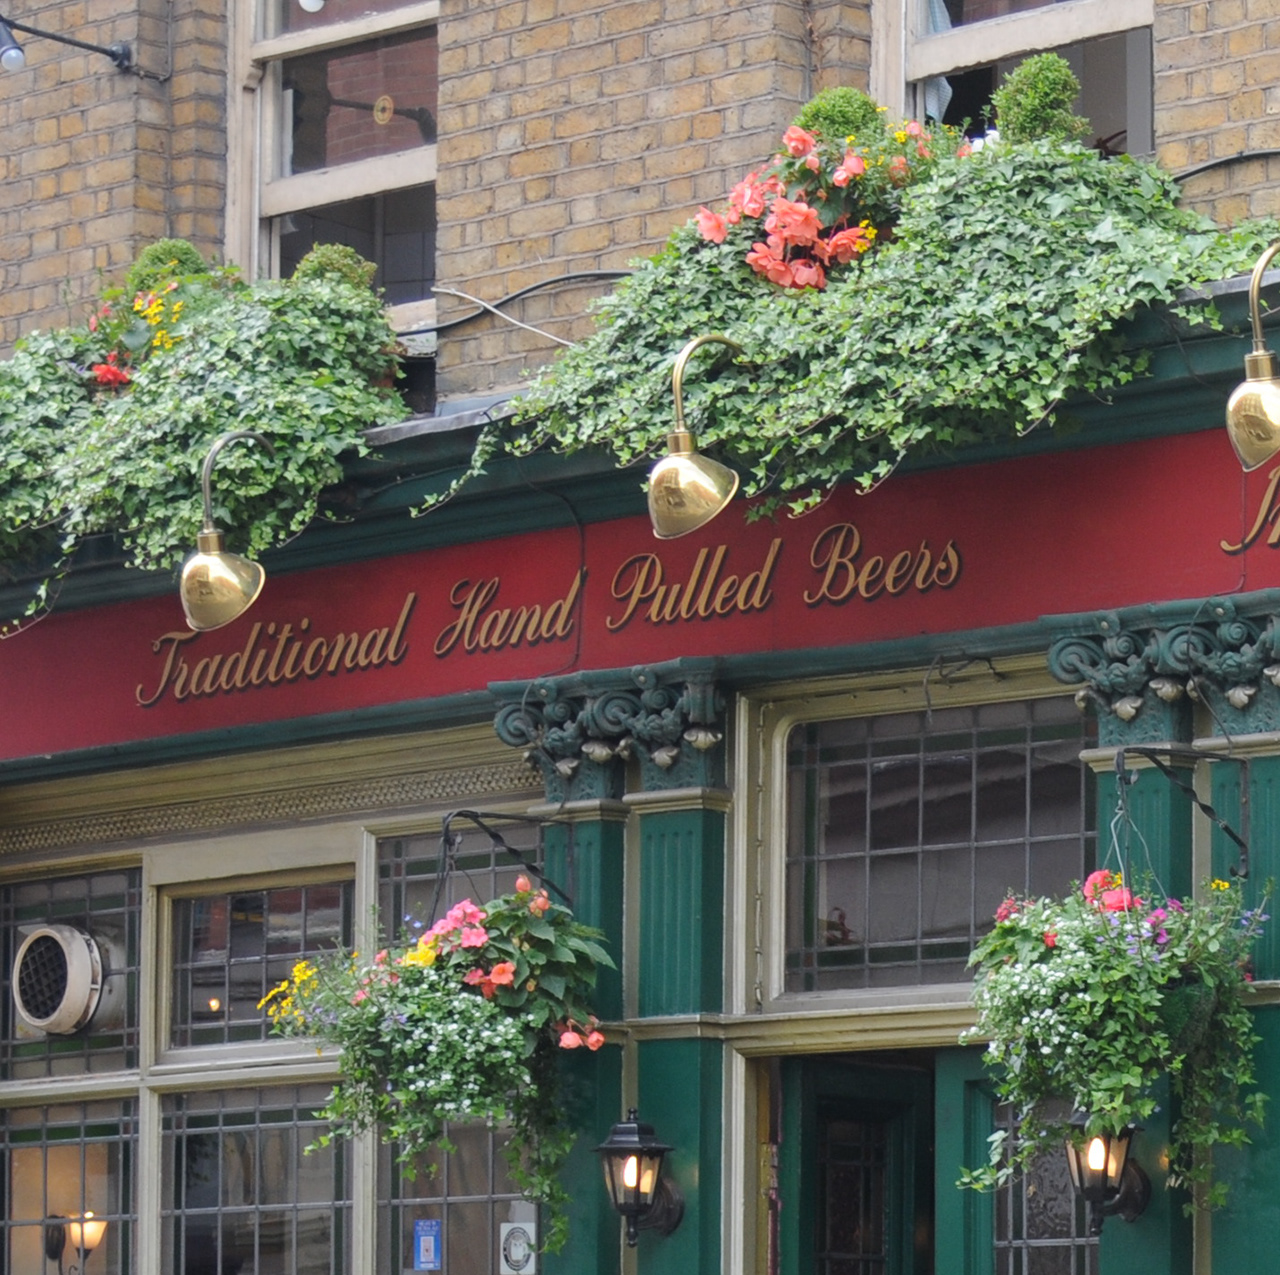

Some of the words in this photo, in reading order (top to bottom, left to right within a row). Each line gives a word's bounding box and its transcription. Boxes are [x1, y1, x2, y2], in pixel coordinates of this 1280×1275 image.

[135, 593, 415, 706] Traditional
[433, 577, 585, 656] Hand
[607, 537, 782, 630] Pulled
[804, 522, 960, 605] Beers
